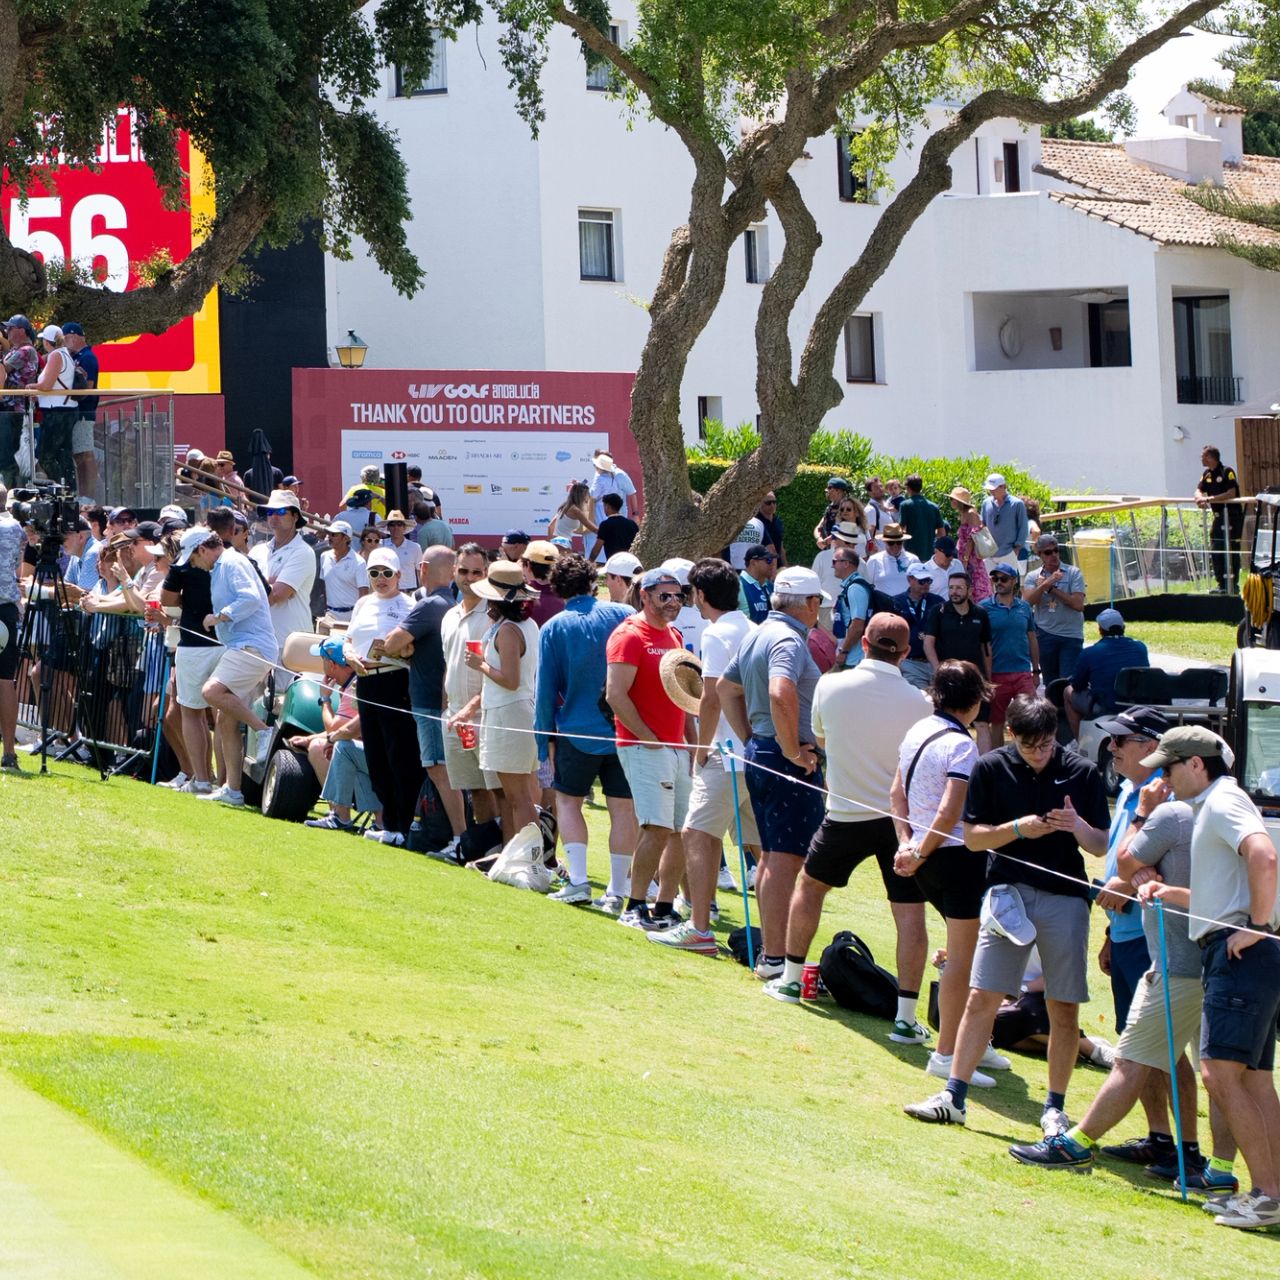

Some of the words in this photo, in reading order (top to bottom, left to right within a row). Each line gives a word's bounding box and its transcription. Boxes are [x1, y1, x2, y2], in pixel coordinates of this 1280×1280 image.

[9, 193, 129, 294] 56
[407, 383, 445, 399] LIV
[443, 383, 490, 399] GOLF
[350, 403, 407, 424] THANK
[409, 404, 443, 425] YOU
[446, 404, 468, 425] TO
[470, 404, 505, 425] OUR
[508, 405, 596, 426] PARTNERS
